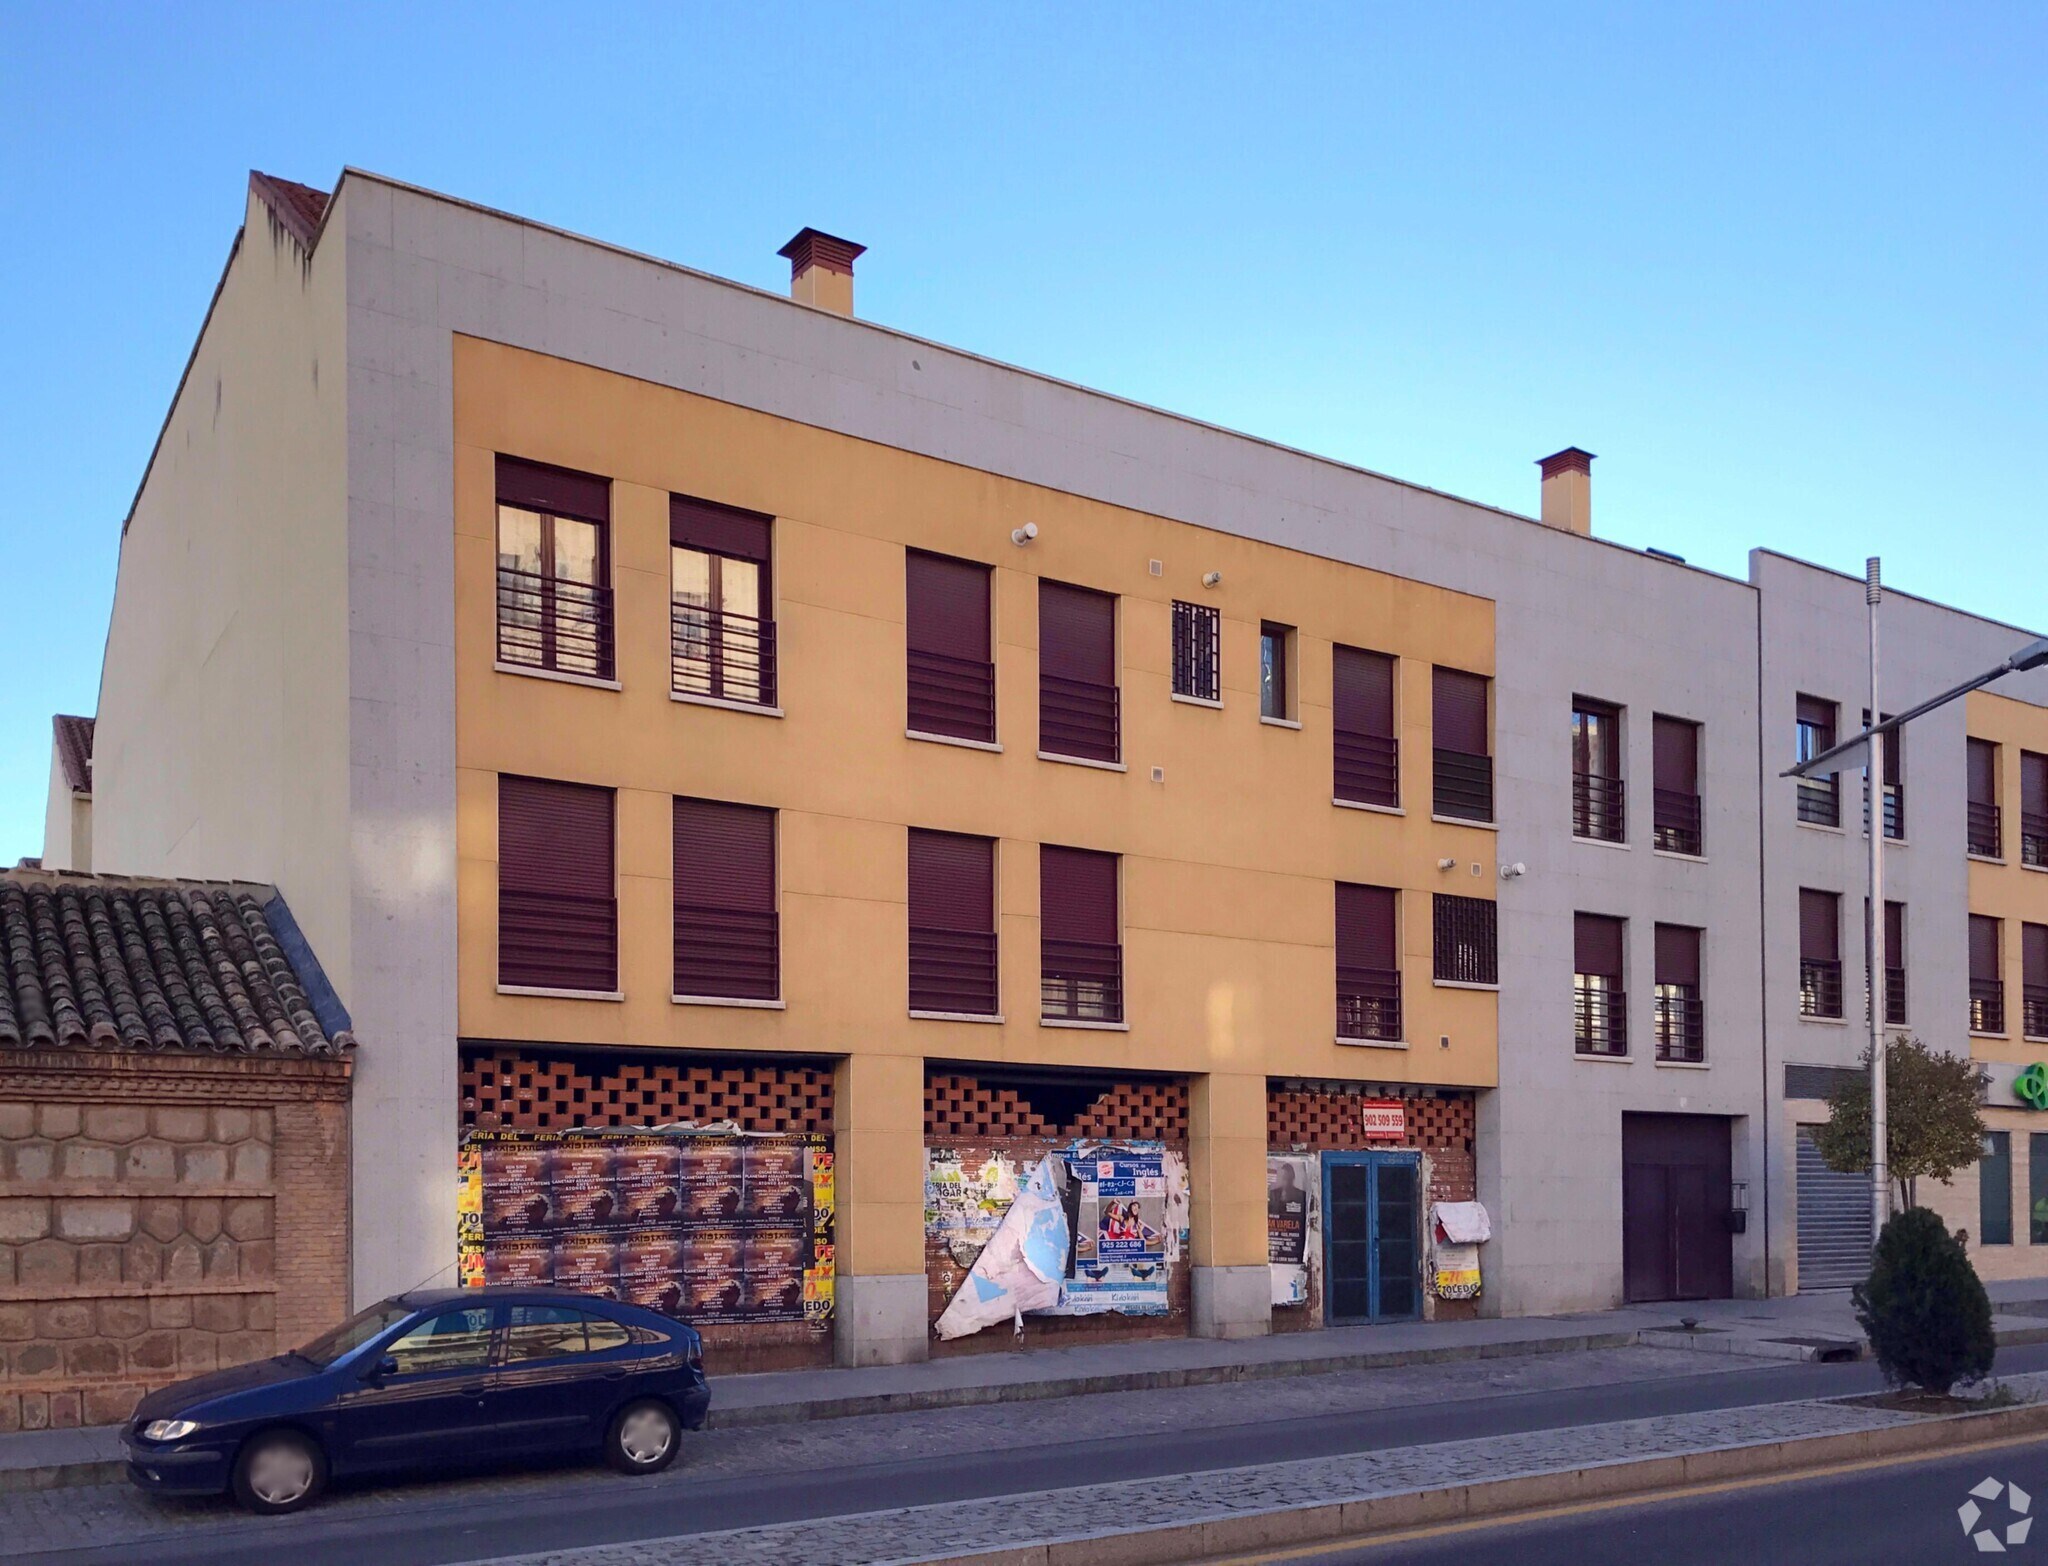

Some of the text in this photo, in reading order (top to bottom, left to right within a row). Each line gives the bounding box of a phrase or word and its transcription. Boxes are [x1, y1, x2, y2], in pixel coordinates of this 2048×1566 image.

[1365, 1114, 1403, 1126] 902 509 559
[471, 1131, 520, 1141] ERIA DEL
[811, 1134, 826, 1142] DEL
[940, 1149, 946, 1159] 7
[1132, 1168, 1159, 1177] Inglés
[1277, 1220, 1300, 1230] VARELA
[463, 1233, 484, 1241] FERI
[1129, 1240, 1142, 1248] 686
[1442, 1284, 1478, 1294] TOLEDO
